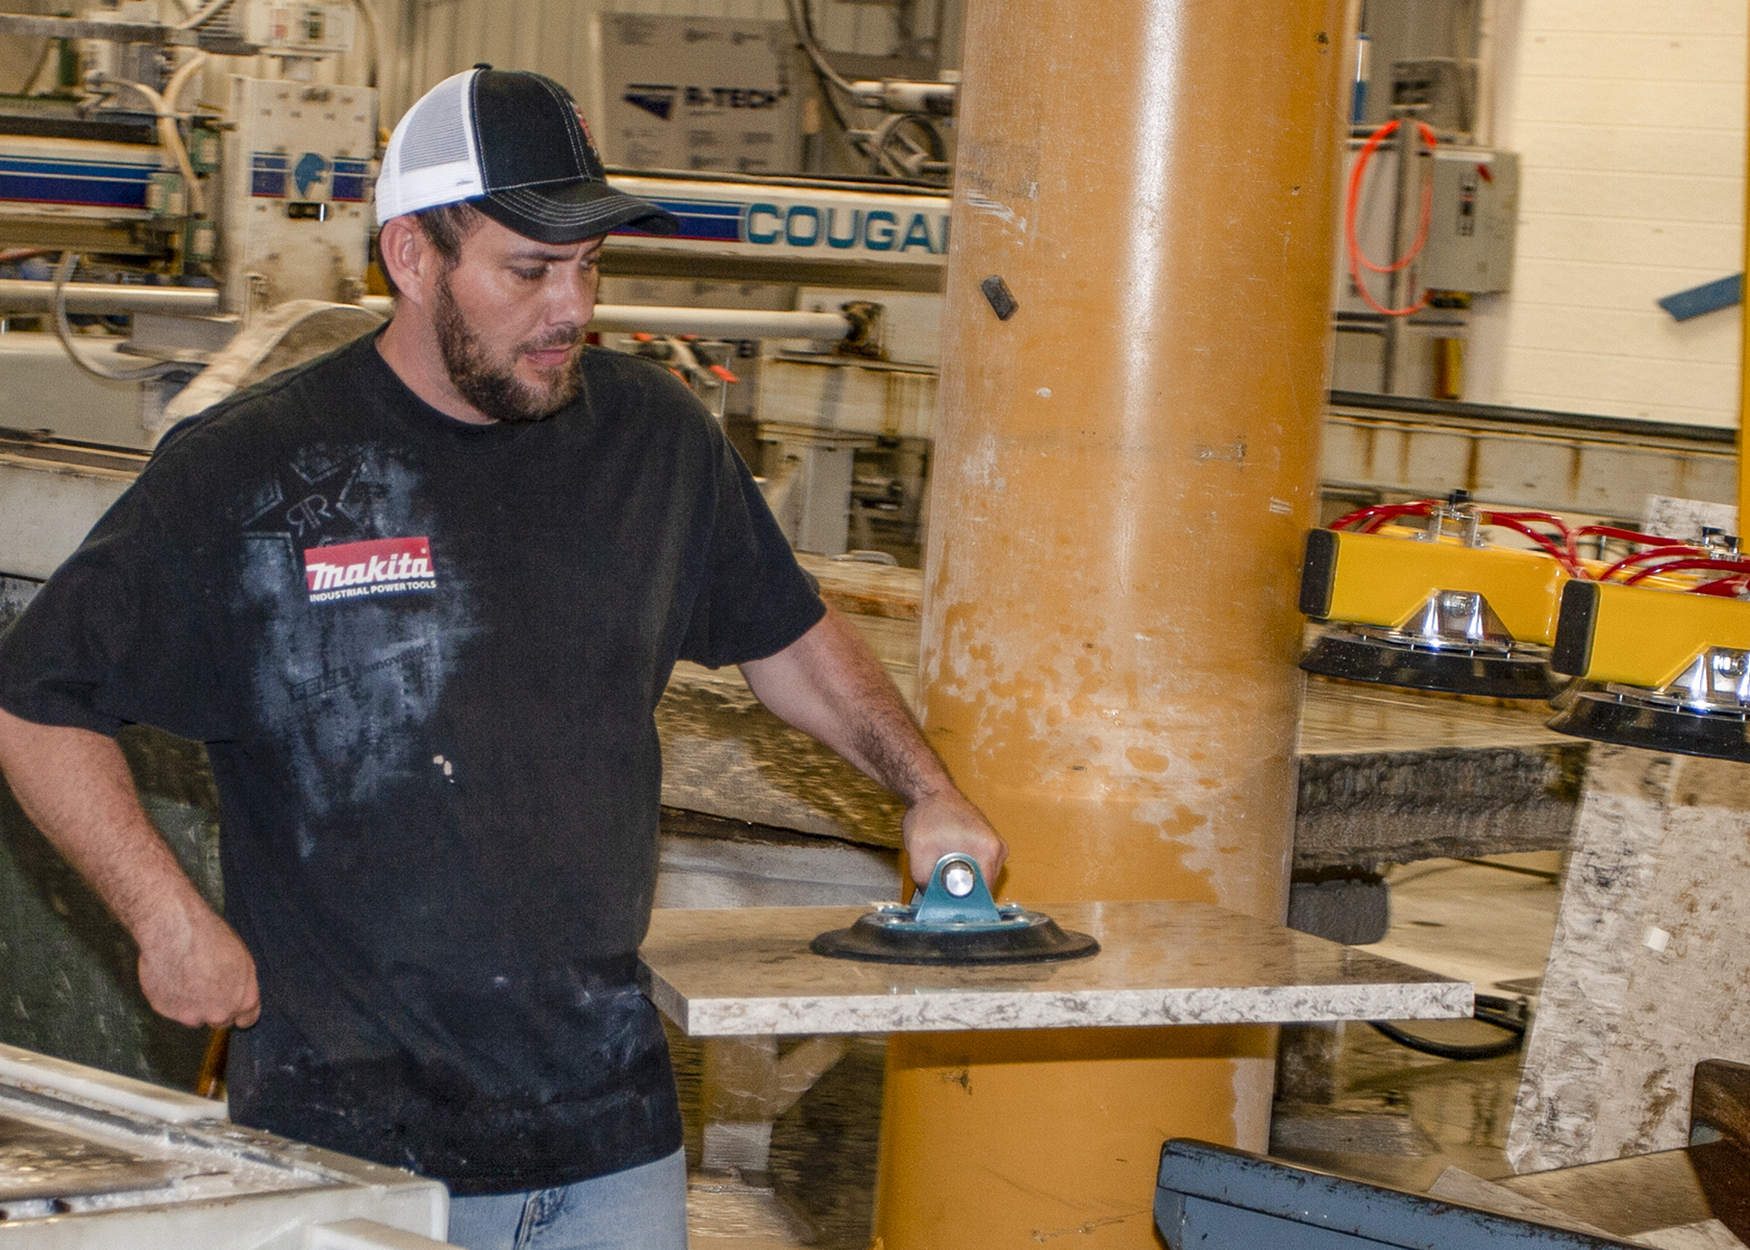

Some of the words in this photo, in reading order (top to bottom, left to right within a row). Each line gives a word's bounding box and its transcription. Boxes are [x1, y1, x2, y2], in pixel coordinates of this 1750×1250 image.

[306, 551, 435, 591] Makita
[309, 586, 370, 603] INDUSTRIAL
[370, 582, 406, 594] POWER
[406, 580, 437, 591] TOOLS
